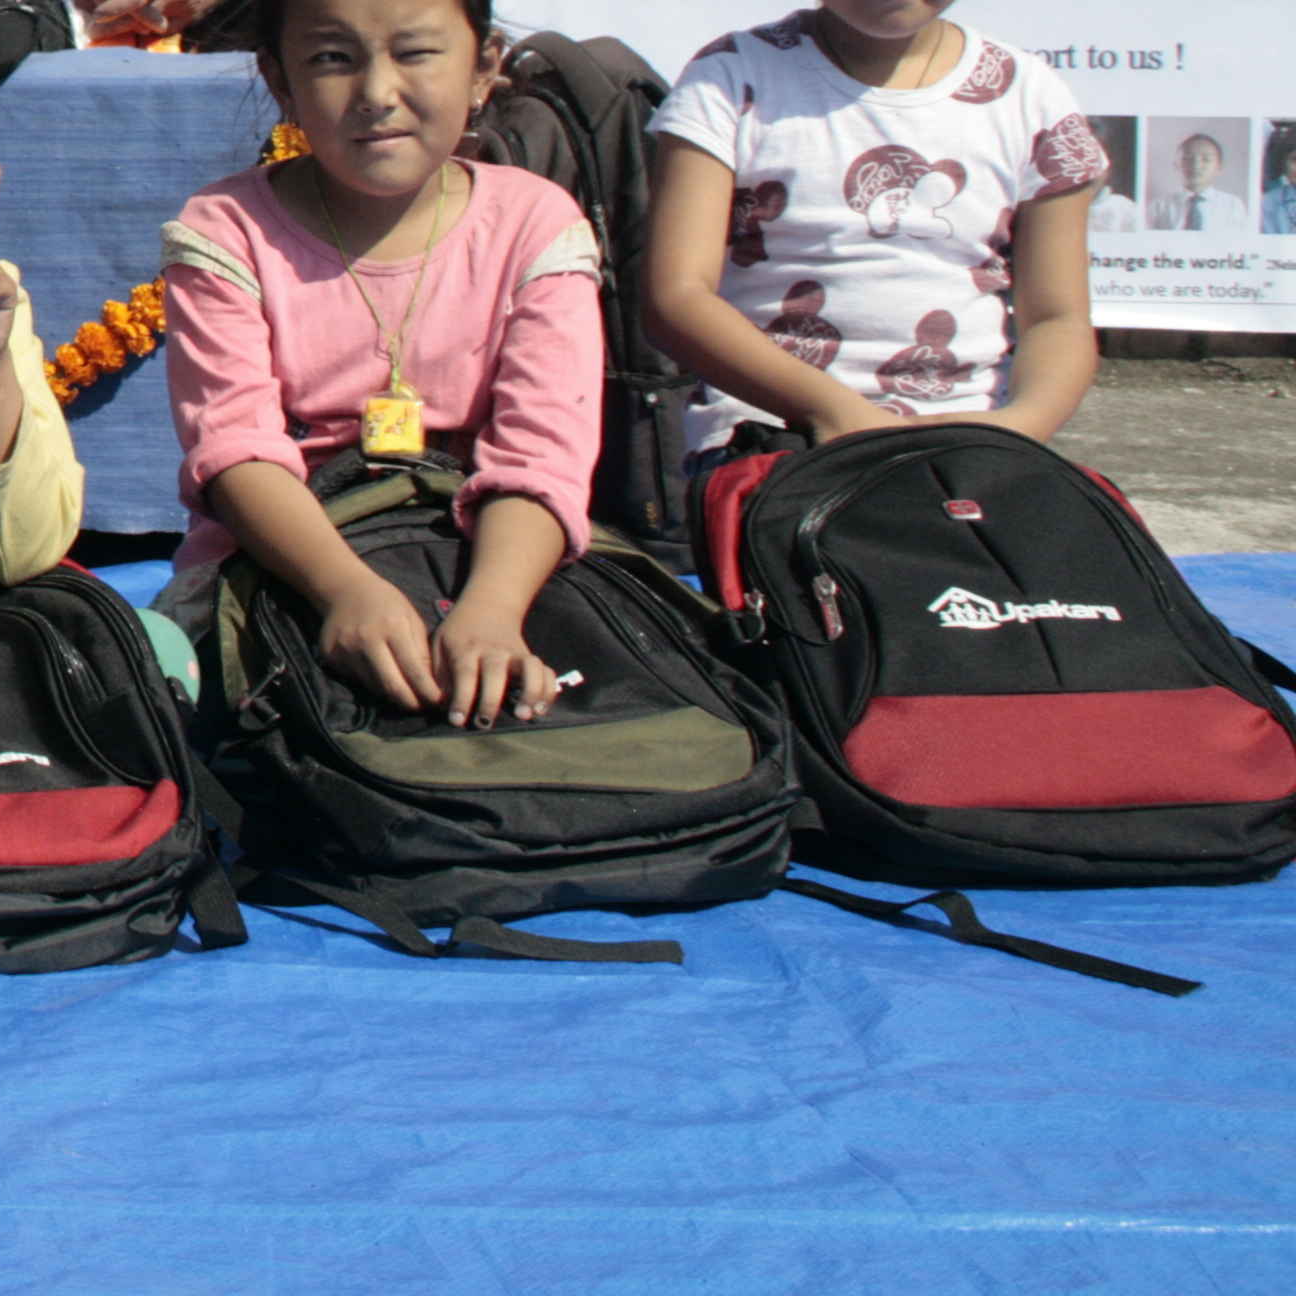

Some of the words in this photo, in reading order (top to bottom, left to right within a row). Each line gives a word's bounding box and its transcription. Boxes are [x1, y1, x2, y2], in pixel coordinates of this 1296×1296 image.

[1025, 43, 1076, 70] ort
[1086, 45, 1118, 70] to
[1127, 49, 1164, 71] us
[1089, 252, 1148, 272] hange
[1153, 252, 1185, 269] the
[1094, 280, 1135, 297] who
[1139, 284, 1168, 297] we
[1172, 285, 1203, 298] are
